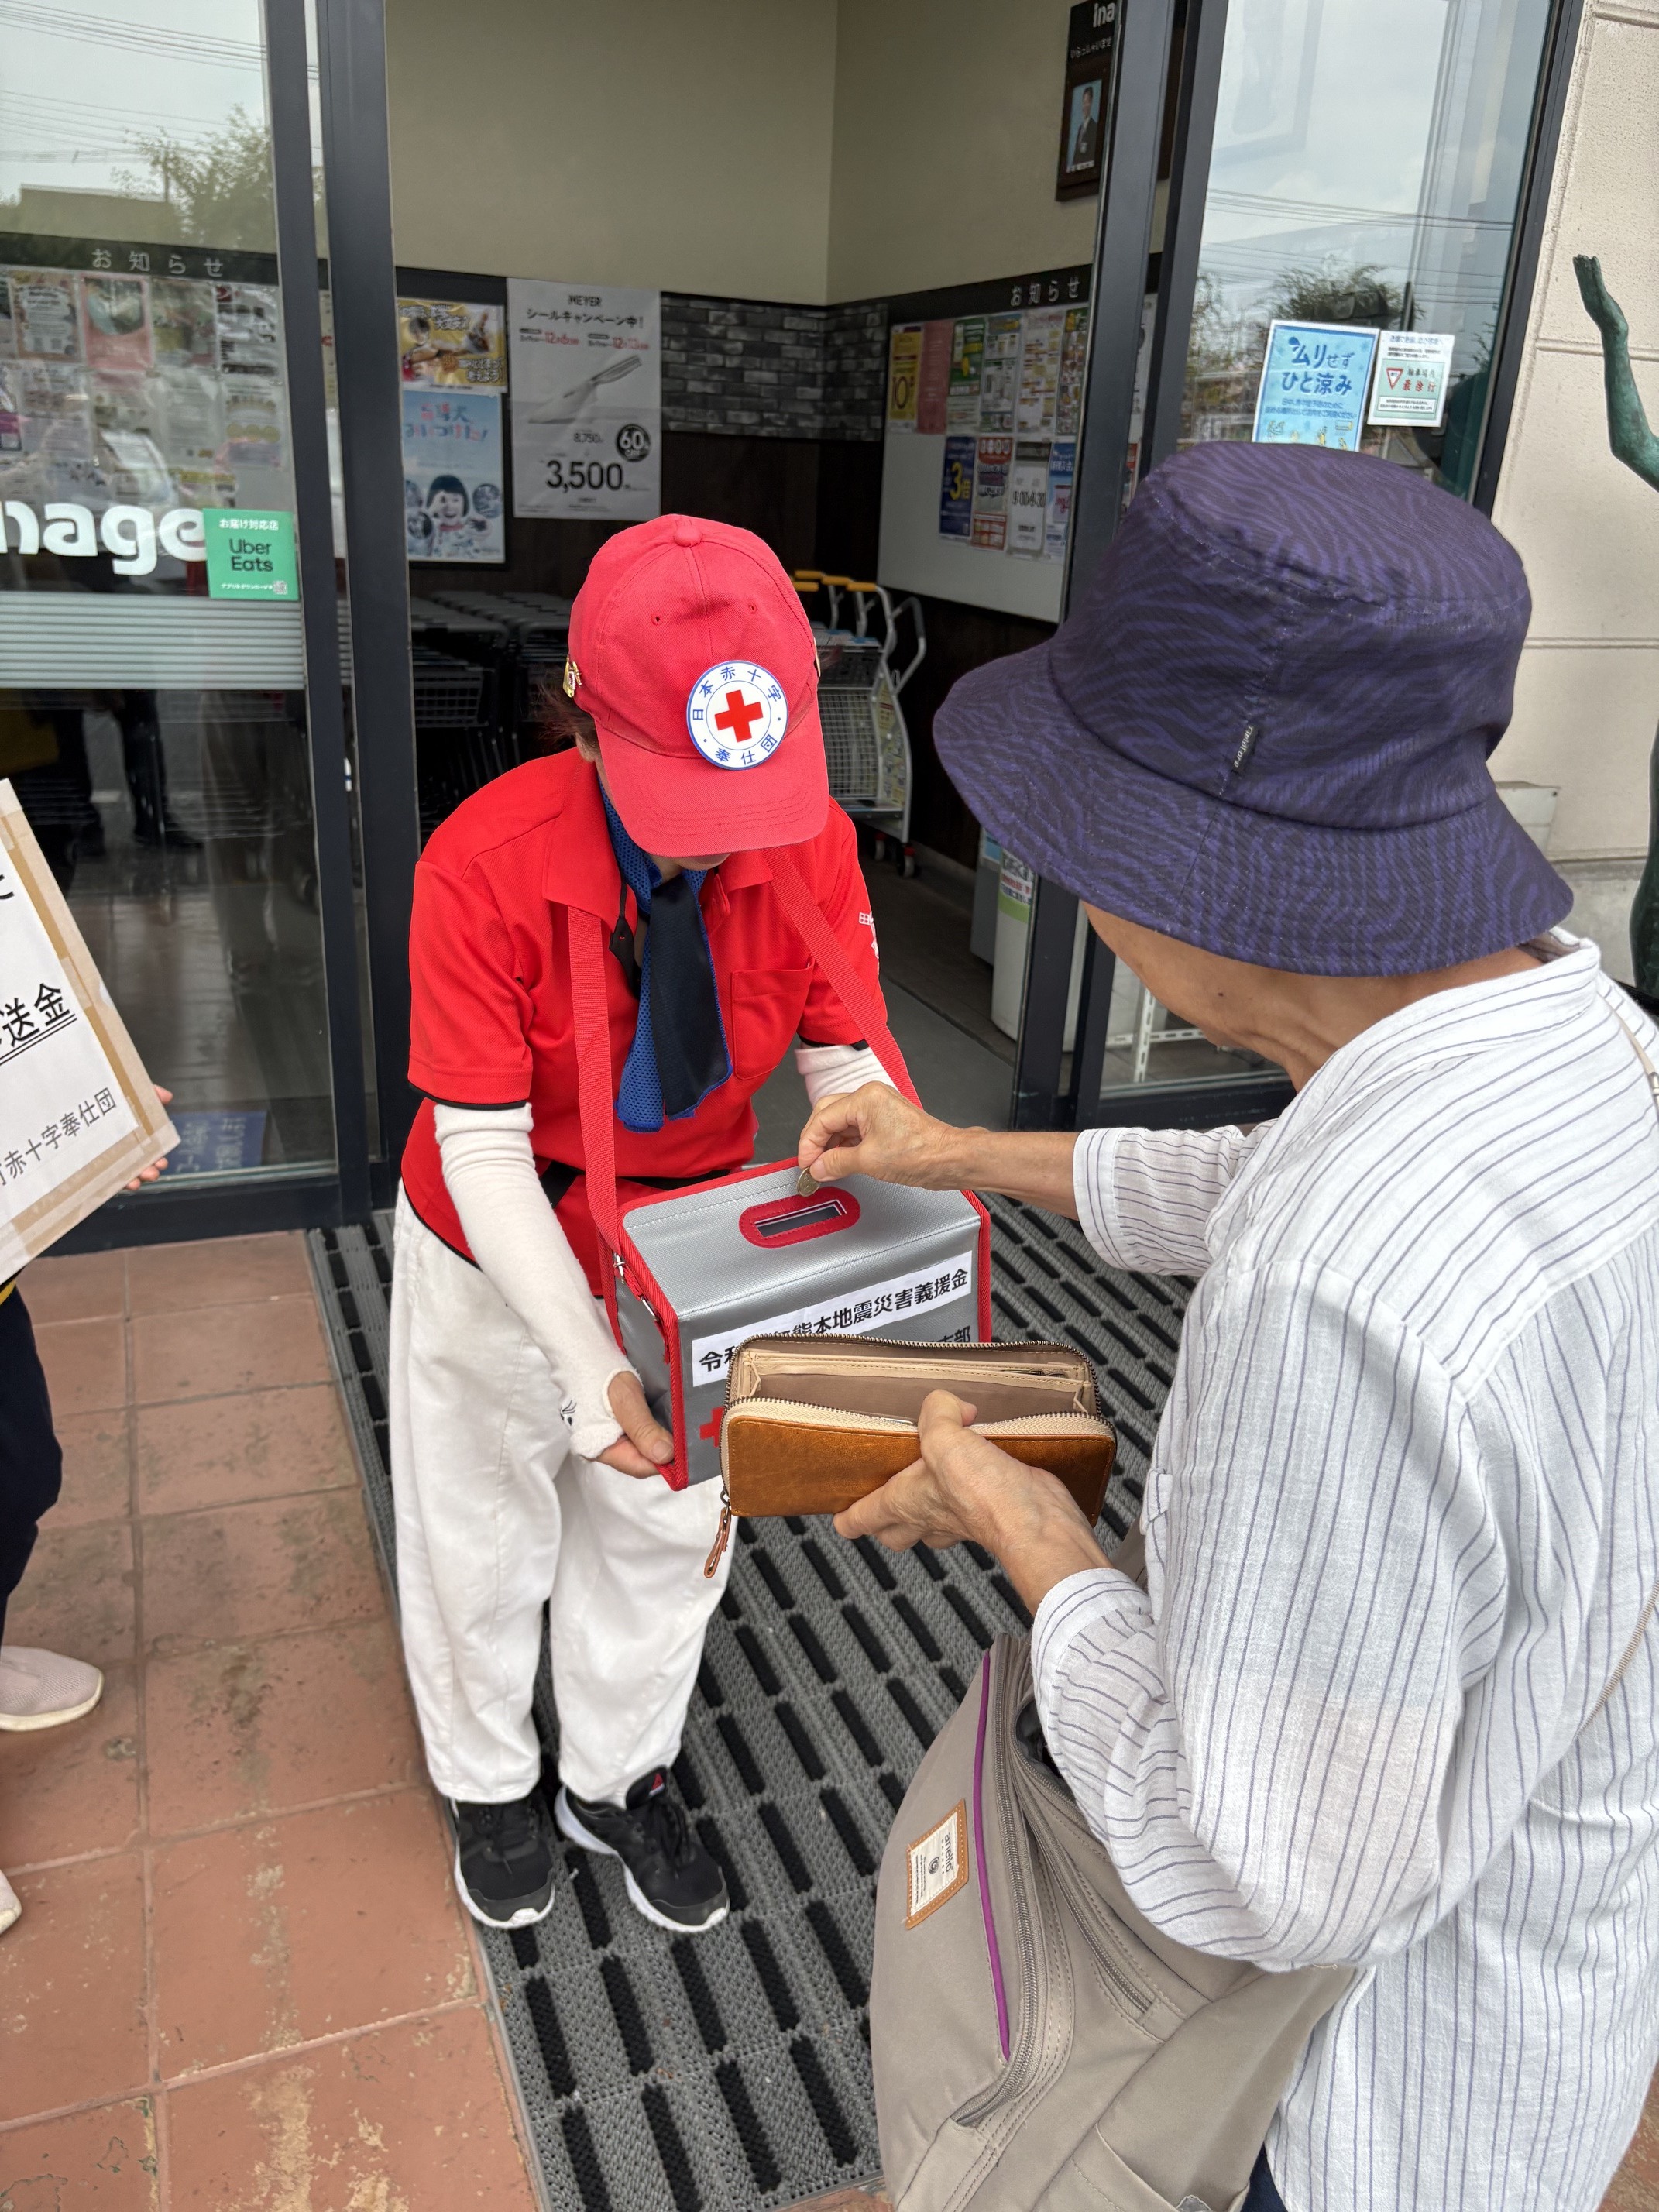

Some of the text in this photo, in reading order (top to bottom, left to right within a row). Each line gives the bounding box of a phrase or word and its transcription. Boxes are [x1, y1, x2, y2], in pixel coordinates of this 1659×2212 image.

[91, 248, 224, 277] お知らせ
[1010, 276, 1080, 307] お知らせ
[1291, 344, 1355, 369] ムリせず
[1282, 372, 1352, 396] ひと涼み
[546, 459, 623, 493] 3,500
[229, 538, 272, 555] Uber
[230, 556, 273, 572] Eats
[692, 665, 782, 721] 日本赤十字
[716, 733, 778, 766] 奉仕団
[0, 983, 70, 1047] 送金
[0, 1087, 117, 1186] 赤十字奉仕団
[945, 1832, 953, 1873] anello
